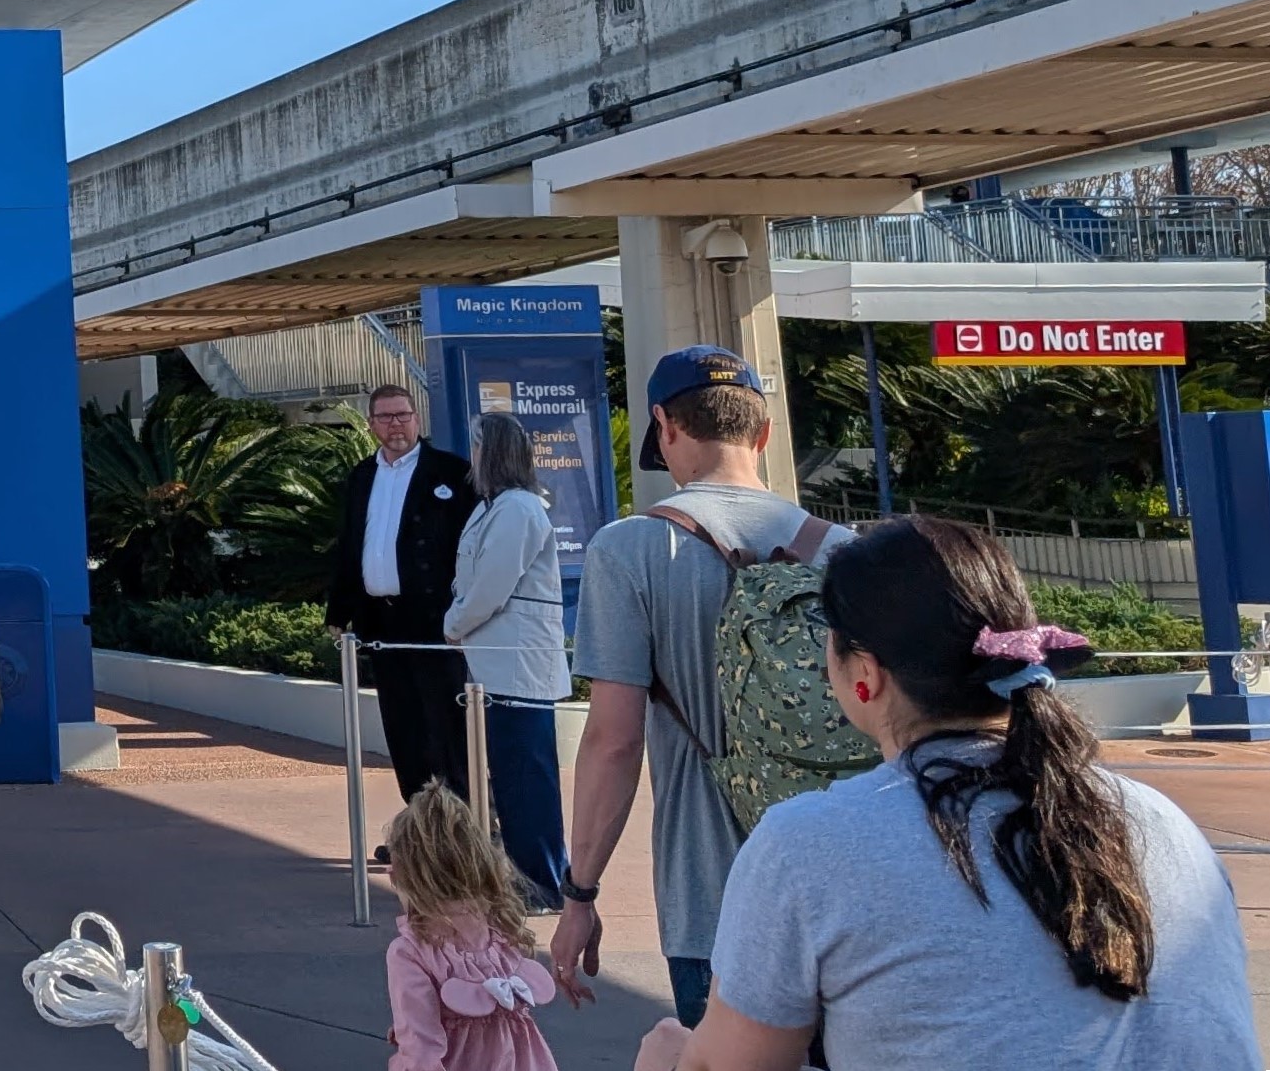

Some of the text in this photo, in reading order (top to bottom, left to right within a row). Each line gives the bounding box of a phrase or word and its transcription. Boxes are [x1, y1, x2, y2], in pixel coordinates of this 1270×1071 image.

[456, 298, 582, 314] Magic Kingdom
[998, 325, 1164, 351] Do Not Enter
[515, 381, 576, 401] Express
[763, 378, 773, 391] PT
[517, 398, 586, 415] Monorail
[532, 430, 576, 442] Service
[534, 443, 553, 455] the
[532, 456, 582, 471] Kingdom
